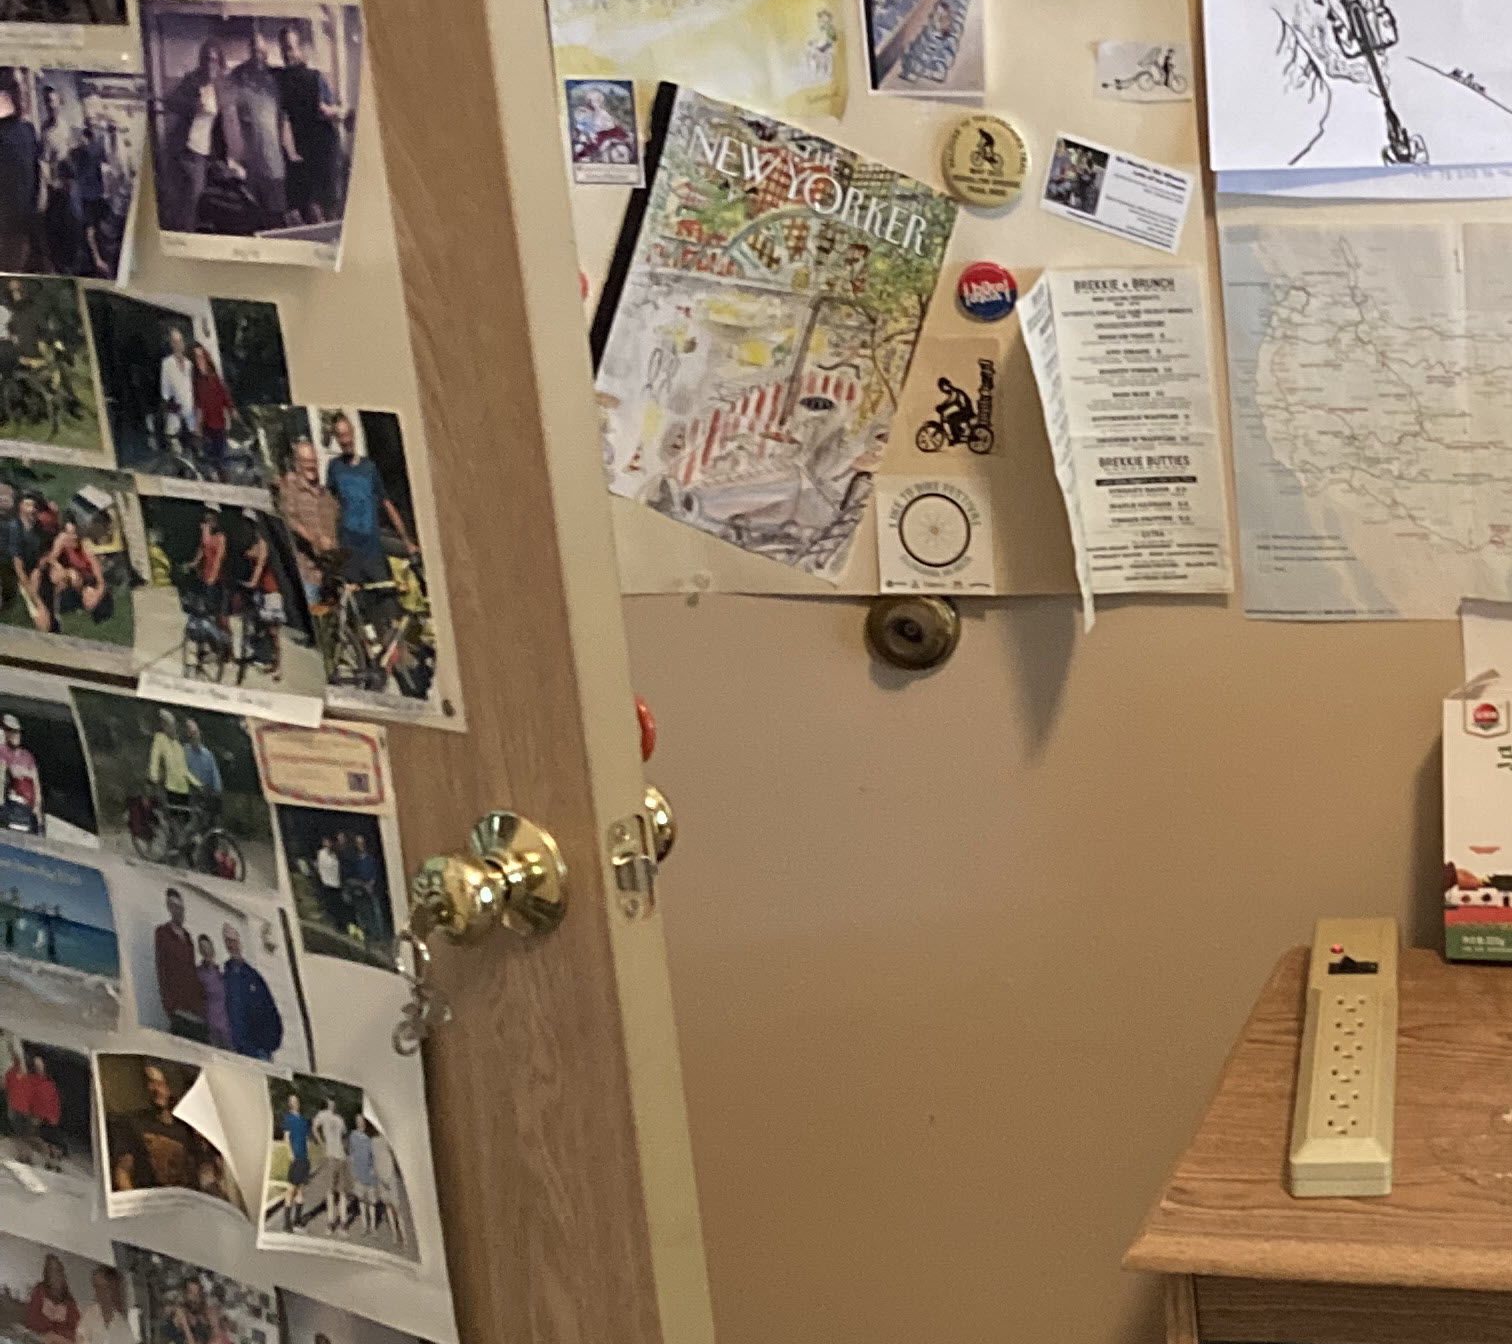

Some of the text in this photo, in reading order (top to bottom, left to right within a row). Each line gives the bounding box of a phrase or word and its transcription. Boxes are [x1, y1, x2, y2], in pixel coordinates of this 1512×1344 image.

[688, 123, 782, 184] NEW
[786, 154, 927, 256] YORKER
[1098, 455, 1190, 468] BREKKIE BUTTIES
